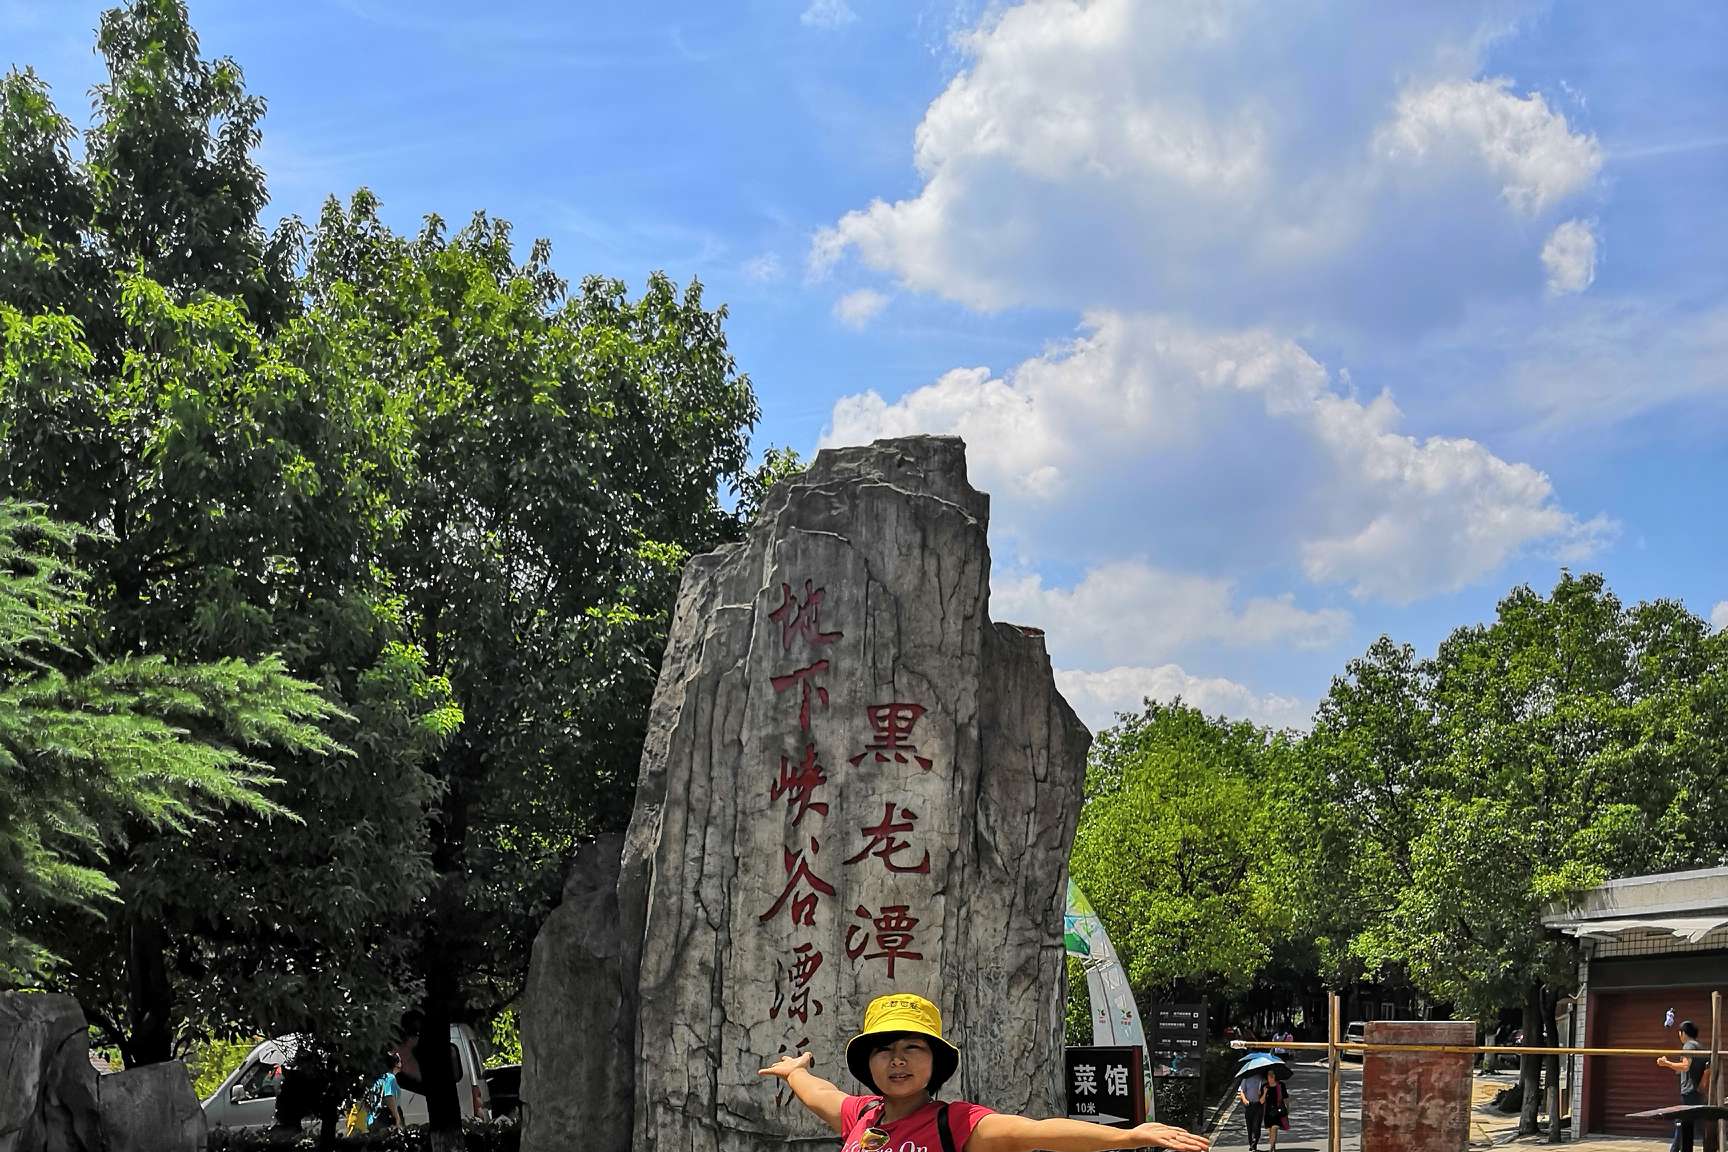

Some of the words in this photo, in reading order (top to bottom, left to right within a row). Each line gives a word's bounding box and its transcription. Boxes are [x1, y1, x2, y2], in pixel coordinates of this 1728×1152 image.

[759, 579, 844, 1068] 地下峡谷漂
[843, 703, 933, 979] 黑龙潭
[1074, 1064, 1129, 1096] 菜馆
[1076, 1102, 1096, 1114] 10米
